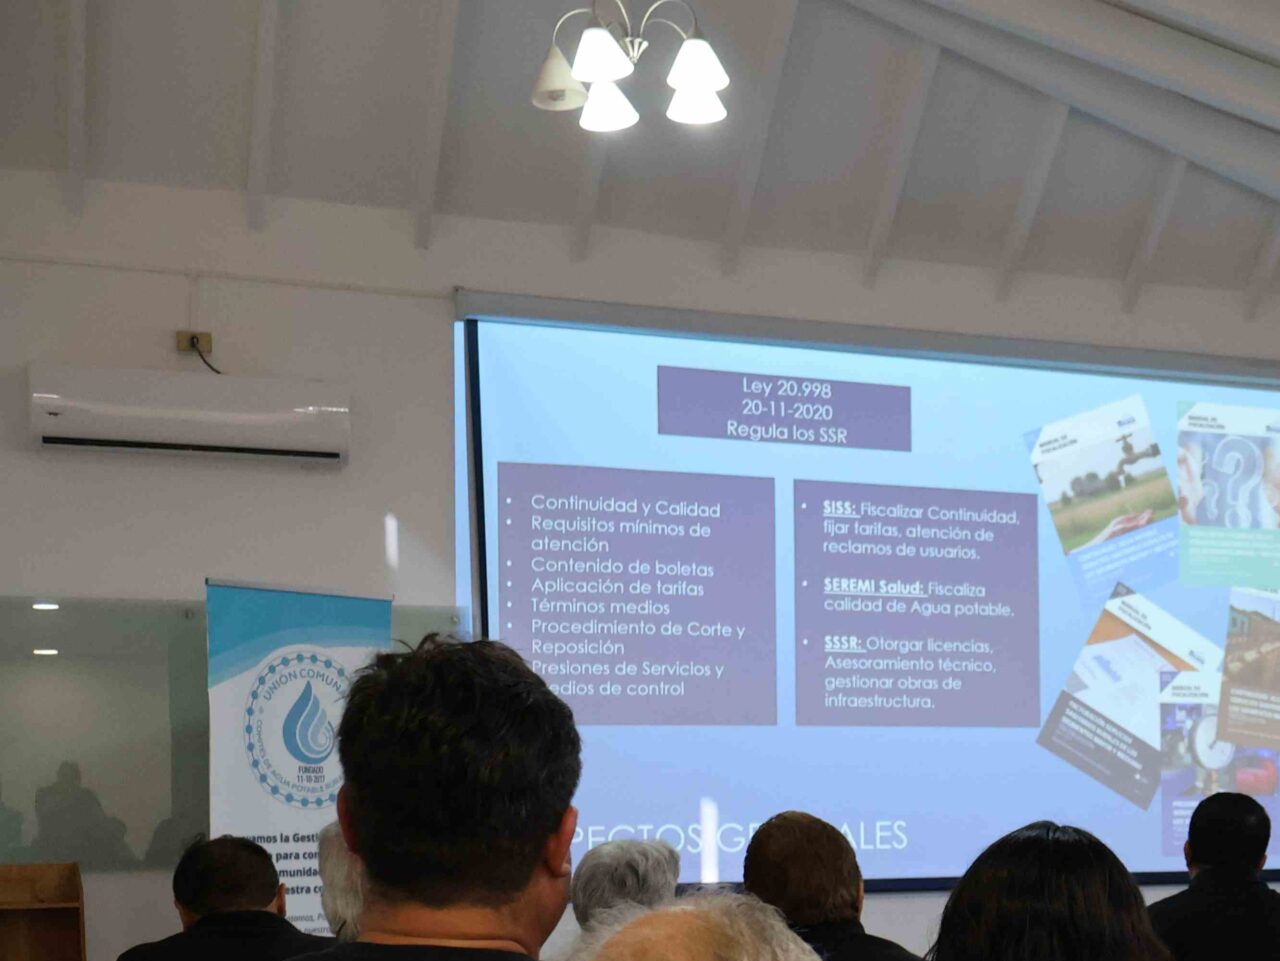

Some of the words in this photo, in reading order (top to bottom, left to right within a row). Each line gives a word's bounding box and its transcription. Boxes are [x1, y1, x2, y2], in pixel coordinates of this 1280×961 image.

[742, 377, 772, 396] Ley
[776, 380, 832, 399] 20.998
[741, 399, 833, 421] 20-11-2020
[726, 421, 788, 442] Regula
[792, 424, 815, 442] los
[818, 426, 848, 444] SSR
[531, 494, 637, 514] Continuidad
[642, 502, 651, 516] y
[655, 500, 721, 518] Calidad
[823, 500, 856, 518] SISS:
[860, 502, 923, 519] Fiscalizar
[928, 506, 1020, 525] Continuidad,
[531, 515, 615, 535] Requisitos
[620, 518, 685, 537] mínimos
[689, 521, 711, 537] de
[823, 521, 849, 537] fijar
[906, 523, 971, 541] atención
[975, 526, 994, 542] de
[531, 537, 609, 553] atención
[823, 541, 892, 557] reclamos
[896, 543, 916, 557] de
[920, 544, 980, 560] usuarios.
[531, 557, 623, 573] Contenido
[628, 558, 651, 574] de
[655, 560, 714, 577] boletas
[531, 578, 624, 598] Aplicación
[629, 580, 652, 595] de
[657, 580, 704, 597] tarifas
[824, 578, 876, 595] SEREMI
[879, 580, 925, 597] Salud:
[928, 582, 985, 597] Fiscaliza
[531, 599, 605, 613] Términos
[610, 600, 670, 615] medios
[824, 597, 882, 613] calidad
[887, 598, 906, 613] de
[910, 600, 951, 617] Agua
[954, 601, 1015, 617] potable.
[531, 619, 655, 635] Procedimiento
[661, 620, 682, 635] de
[688, 620, 731, 637] Corte
[736, 625, 745, 639] y
[531, 640, 624, 656] Reposición
[824, 636, 862, 653] SSSR:
[866, 637, 923, 654] Otorgar
[927, 638, 994, 655] licencias,
[532, 660, 610, 675] Presiones
[615, 661, 636, 675] de
[642, 661, 711, 677] Servicios
[715, 665, 724, 679] y
[824, 655, 934, 671] Asesoramiento
[938, 657, 997, 673] técnico,
[299, 668, 342, 692] COMUN
[549, 681, 595, 696] edios
[599, 681, 621, 696] de
[627, 682, 685, 696] control
[825, 675, 893, 691] gestionar
[897, 675, 938, 690] obras
[942, 676, 961, 690] de
[824, 693, 935, 709] infraestructura.
[280, 833, 290, 843] la
[293, 833, 319, 843] Gesti
[573, 823, 703, 853] PECTOS
[716, 819, 908, 853] GALES
[276, 851, 300, 863] para
[279, 867, 318, 877] munida
[286, 886, 311, 895] estra
